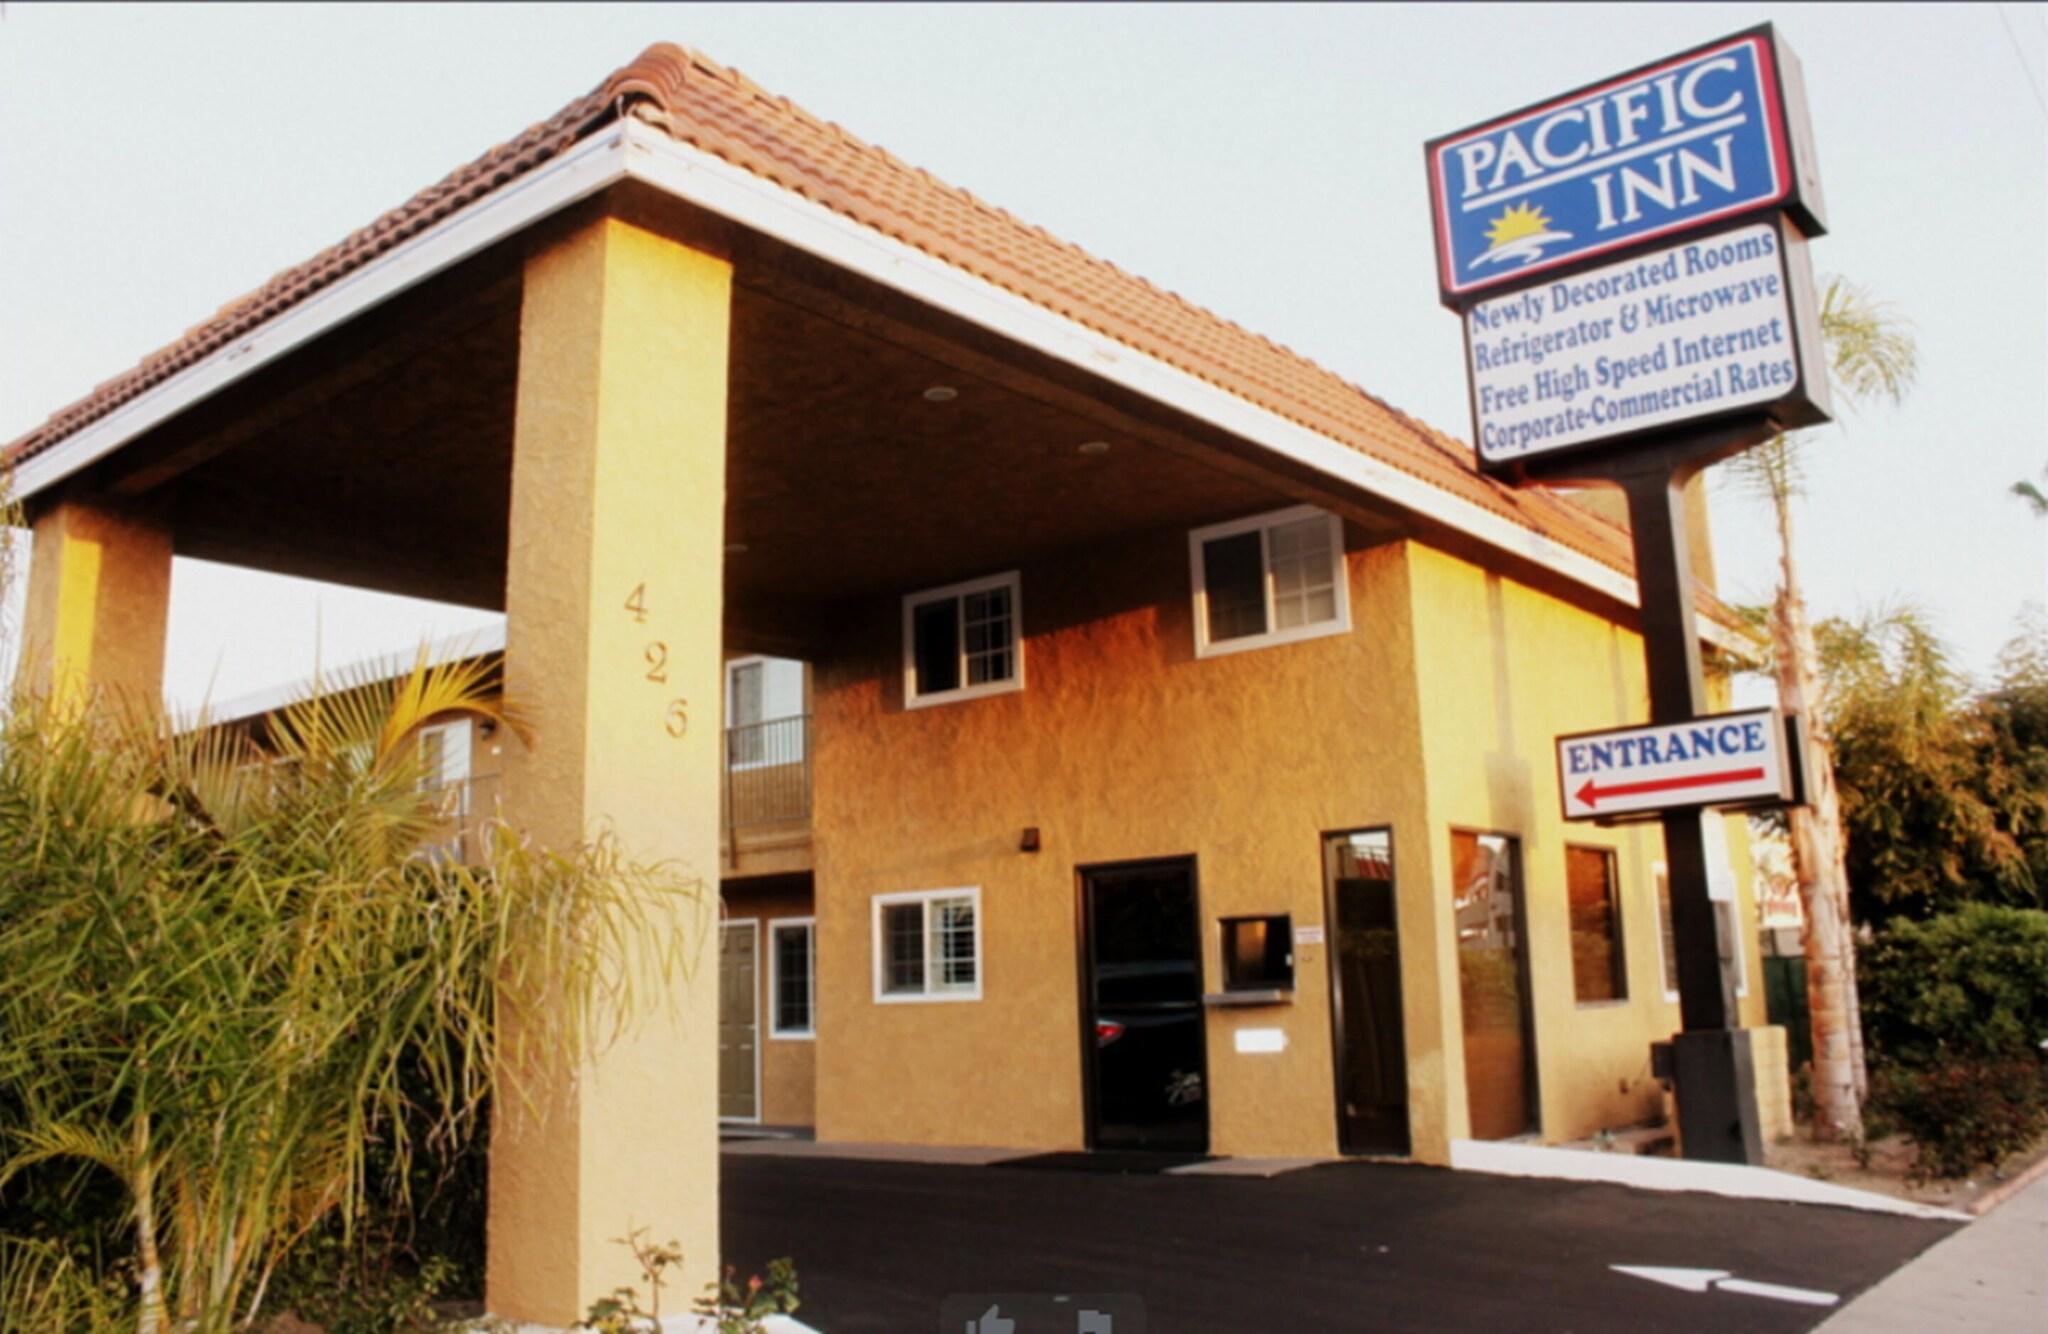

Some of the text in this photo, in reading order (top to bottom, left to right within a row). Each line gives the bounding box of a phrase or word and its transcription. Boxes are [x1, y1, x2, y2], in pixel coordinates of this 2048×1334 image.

[1457, 57, 1744, 198] PACIFIC
[1591, 134, 1735, 230] INN
[1472, 233, 1774, 334] Newly Decorated Rooms
[1475, 274, 1778, 372] Refrigerator & Microwave
[1480, 317, 1782, 414] Free High Speed Internet
[1483, 359, 1793, 450] Corporate-Commercial Rates
[1567, 721, 1766, 774] ENTRANCE
